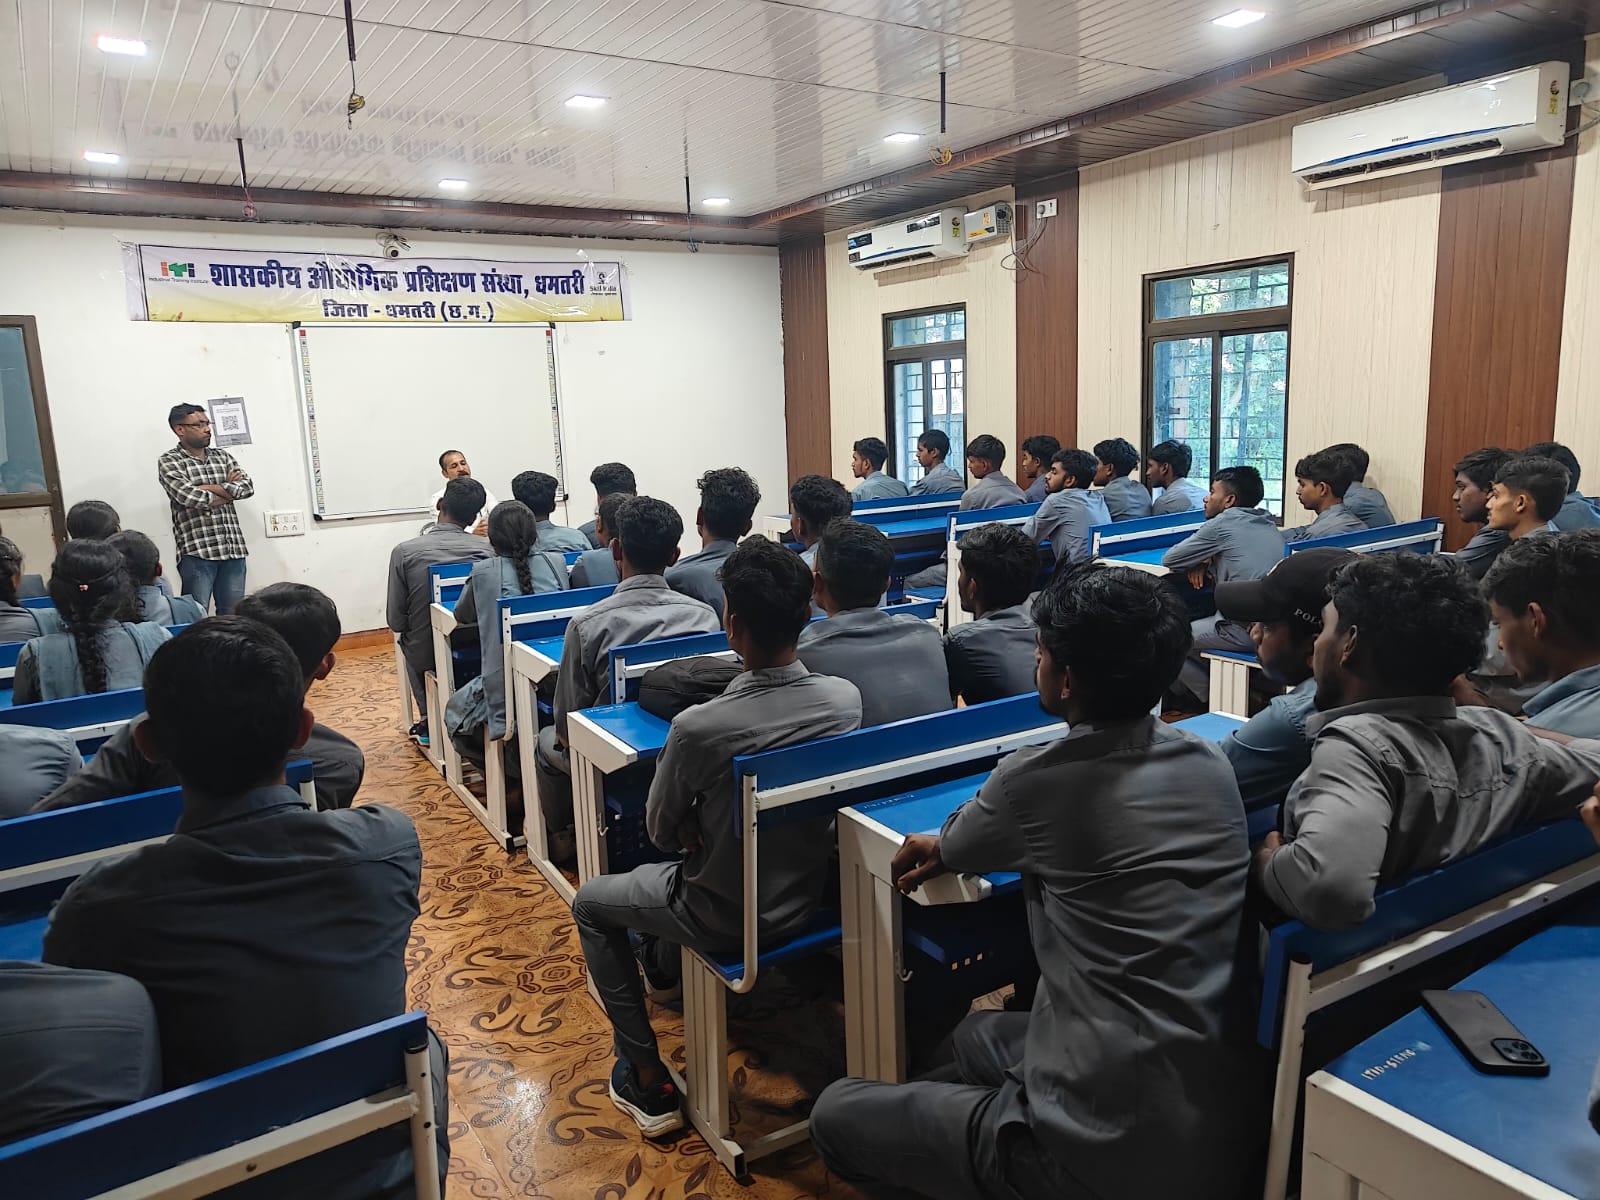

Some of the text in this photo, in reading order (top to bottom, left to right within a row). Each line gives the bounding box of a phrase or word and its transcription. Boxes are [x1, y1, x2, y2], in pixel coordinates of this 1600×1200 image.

[209, 259, 301, 289] शासकीय
[402, 265, 476, 292] प्रशिक्षण
[480, 267, 529, 298] संस्था,
[534, 269, 585, 295] धमतरी
[322, 299, 369, 318] जिला
[385, 301, 436, 319] धमतरी
[440, 300, 494, 323] (छ.ग.)
